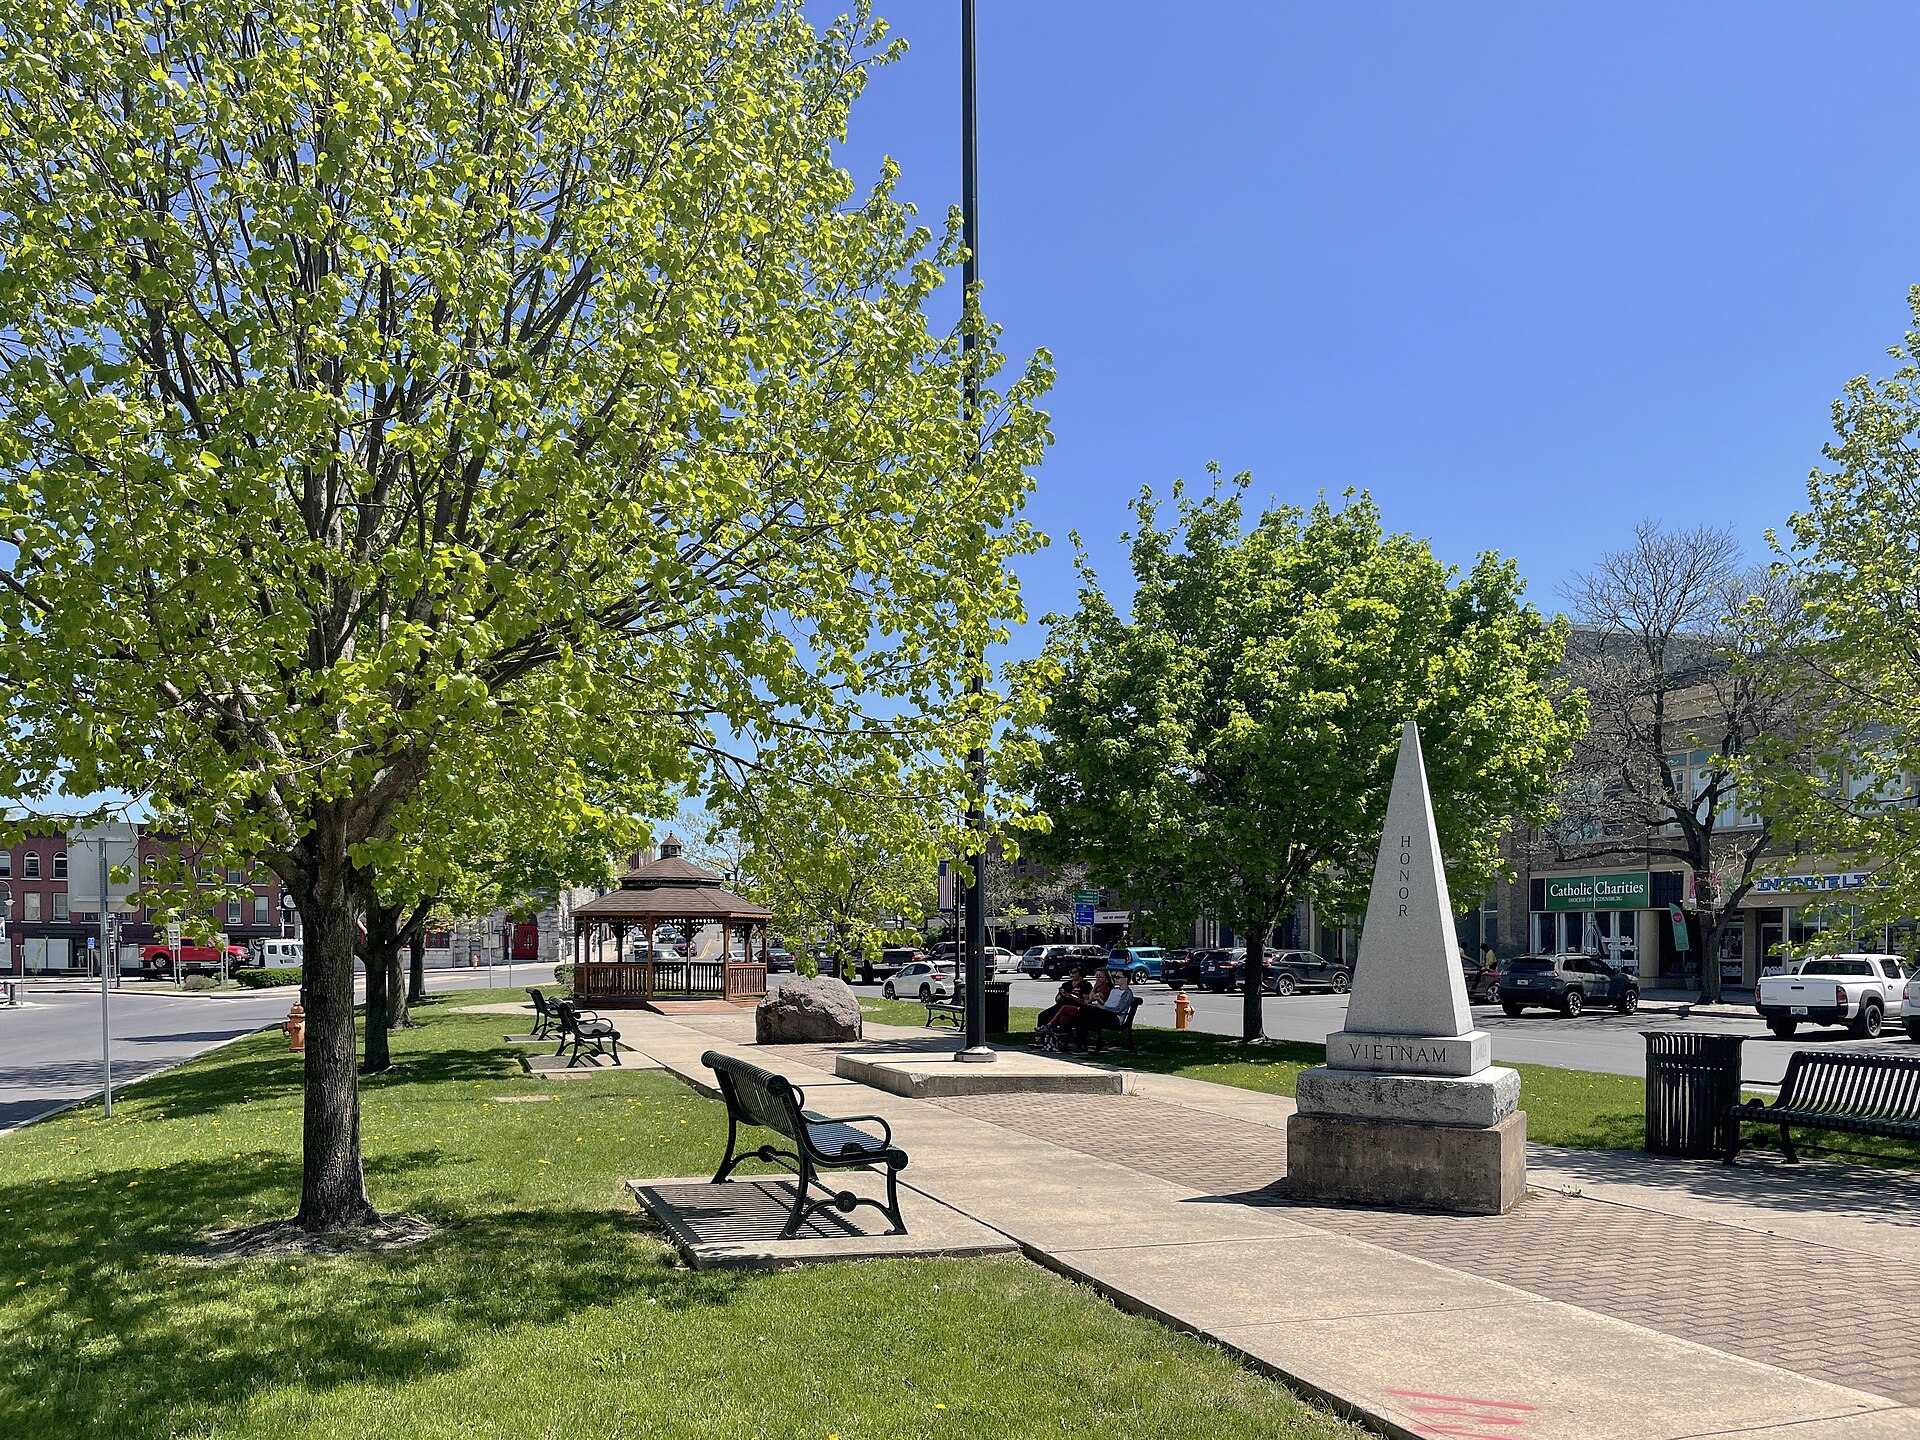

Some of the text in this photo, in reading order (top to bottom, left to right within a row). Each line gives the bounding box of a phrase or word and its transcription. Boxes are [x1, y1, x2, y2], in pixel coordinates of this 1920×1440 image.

[1398, 835, 1411, 917] HONOR
[1550, 880, 1644, 897] Catholic Charities
[1349, 1043, 1447, 1063] VIETNAM
